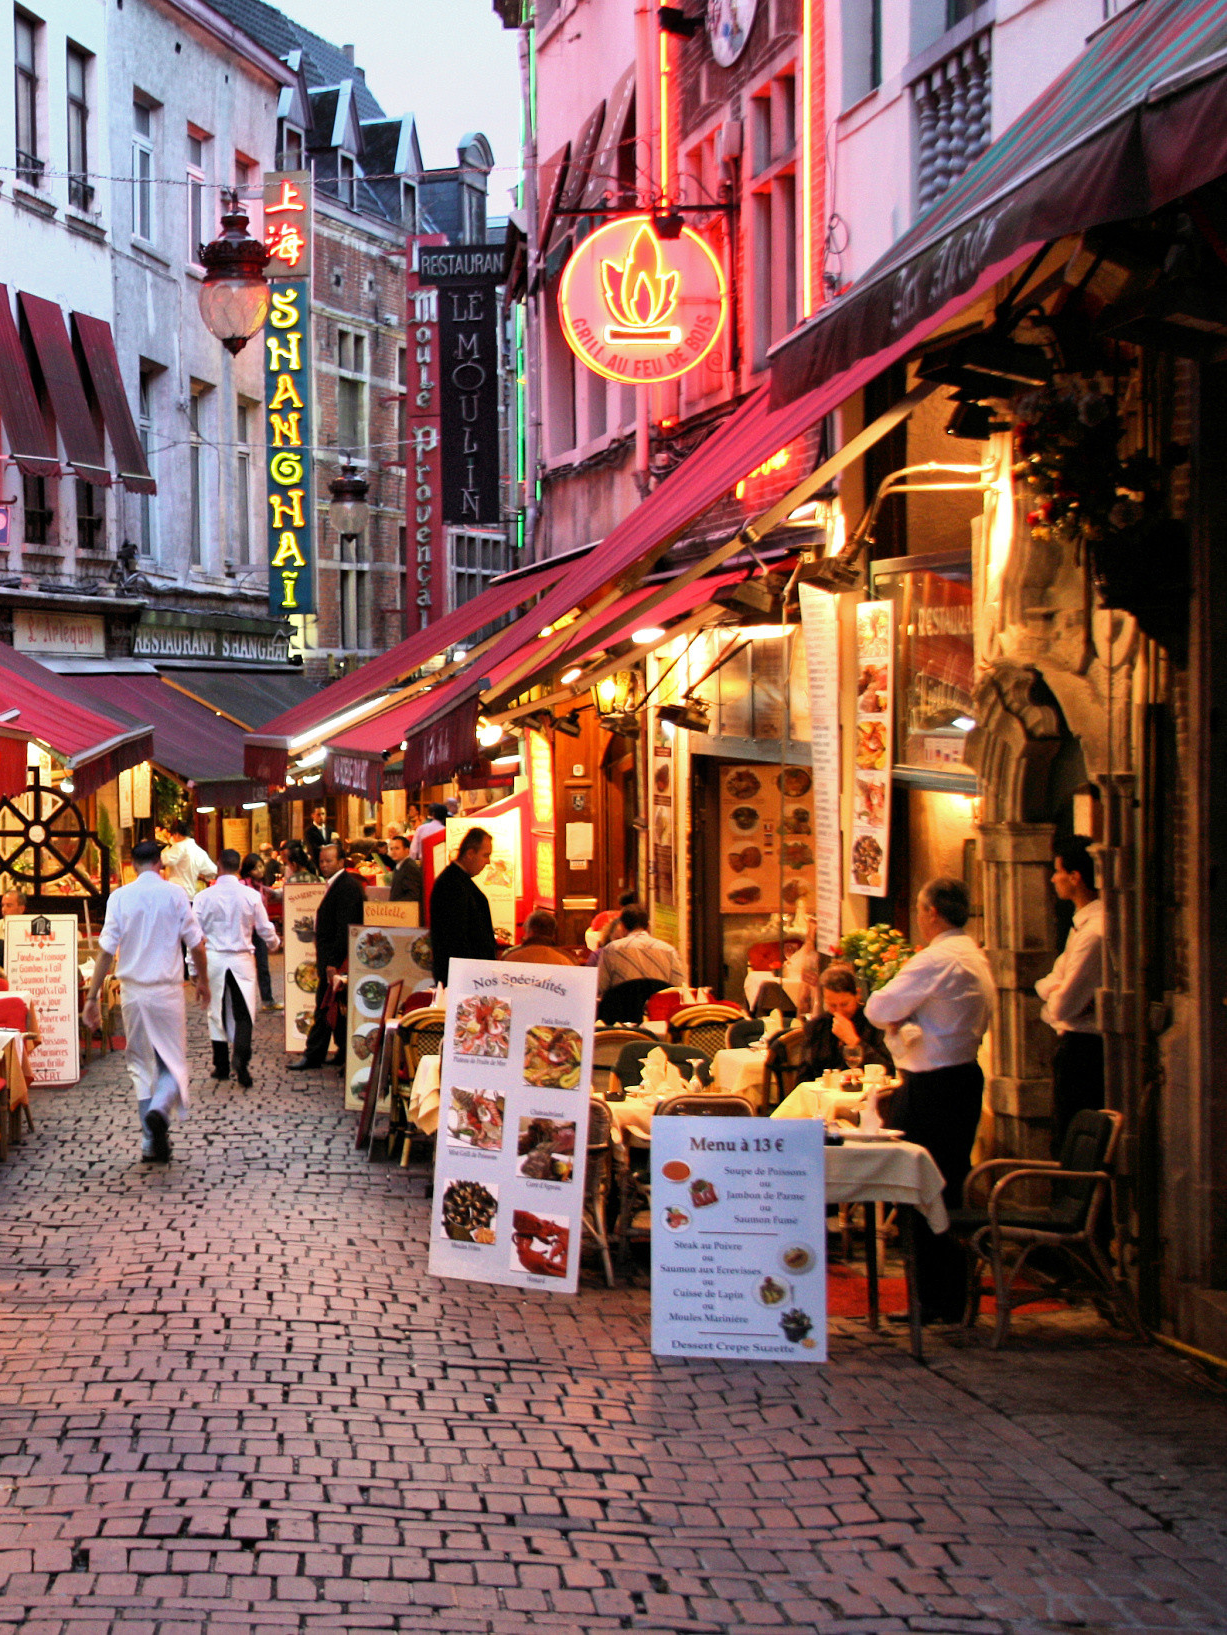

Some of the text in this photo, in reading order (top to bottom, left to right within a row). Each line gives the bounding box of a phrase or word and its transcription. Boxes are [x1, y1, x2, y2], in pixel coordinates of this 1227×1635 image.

[264, 180, 306, 266] 上海
[422, 252, 505, 276] RESTAURAN
[572, 314, 714, 377] GRILL AU FEU DE BOIS
[449, 292, 486, 520] LE MOULIN
[134, 627, 216, 656] RESTAURANT
[473, 974, 568, 997] Nos Spécialités
[33, 1072, 62, 1081] SSERT
[689, 1136, 785, 1152] Menu à 13 €
[723, 1166, 807, 1177] Soupe de Poissons
[726, 1190, 805, 1201] Jambon de Parme
[734, 1215, 770, 1224] Saumon
[674, 1241, 698, 1250] Steak
[713, 1241, 742, 1251] Poivre
[660, 1264, 696, 1274] Saumon
[699, 1266, 714, 1274] aux
[702, 1278, 714, 1286] ou
[672, 1288, 744, 1300] Cuisse de Lapin
[669, 1312, 702, 1322] Moules
[671, 1340, 714, 1350] Dessert
